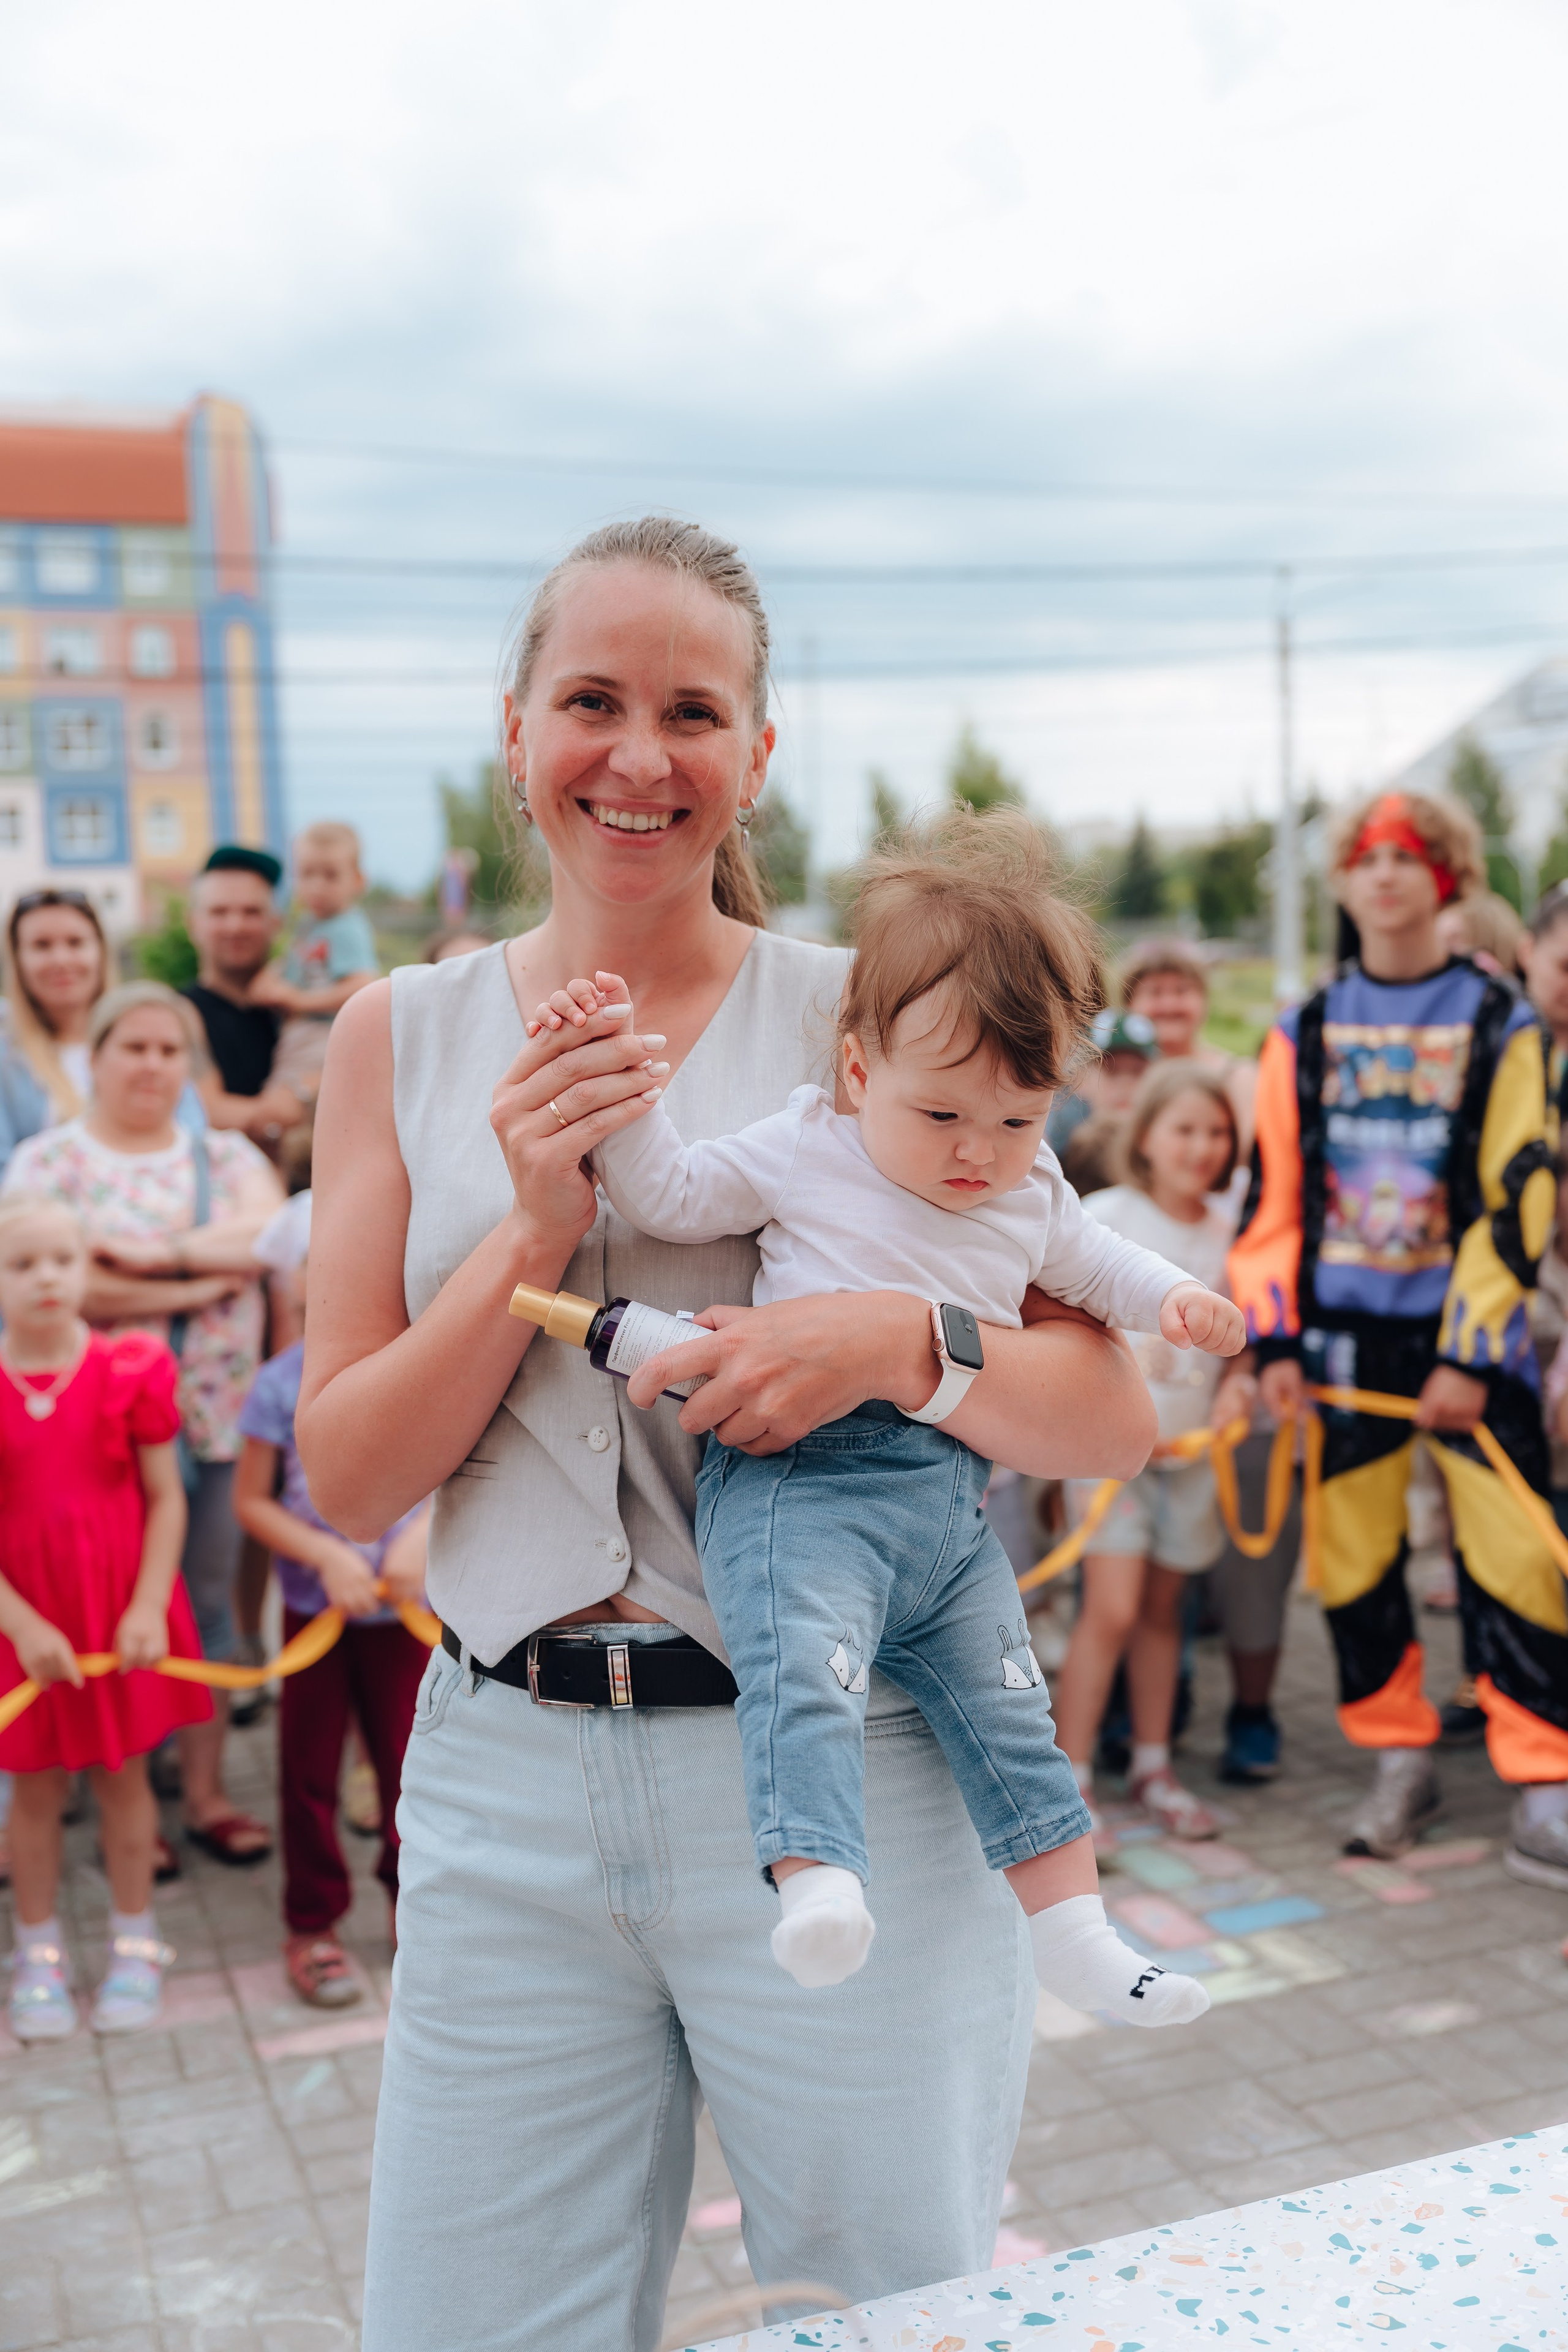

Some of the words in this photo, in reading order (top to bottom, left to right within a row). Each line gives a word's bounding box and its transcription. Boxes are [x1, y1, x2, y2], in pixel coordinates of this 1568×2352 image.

[611, 1344, 620, 1363] Парфюм
[617, 1328, 626, 1345] Forever
[623, 1316, 631, 1329] Fresh
